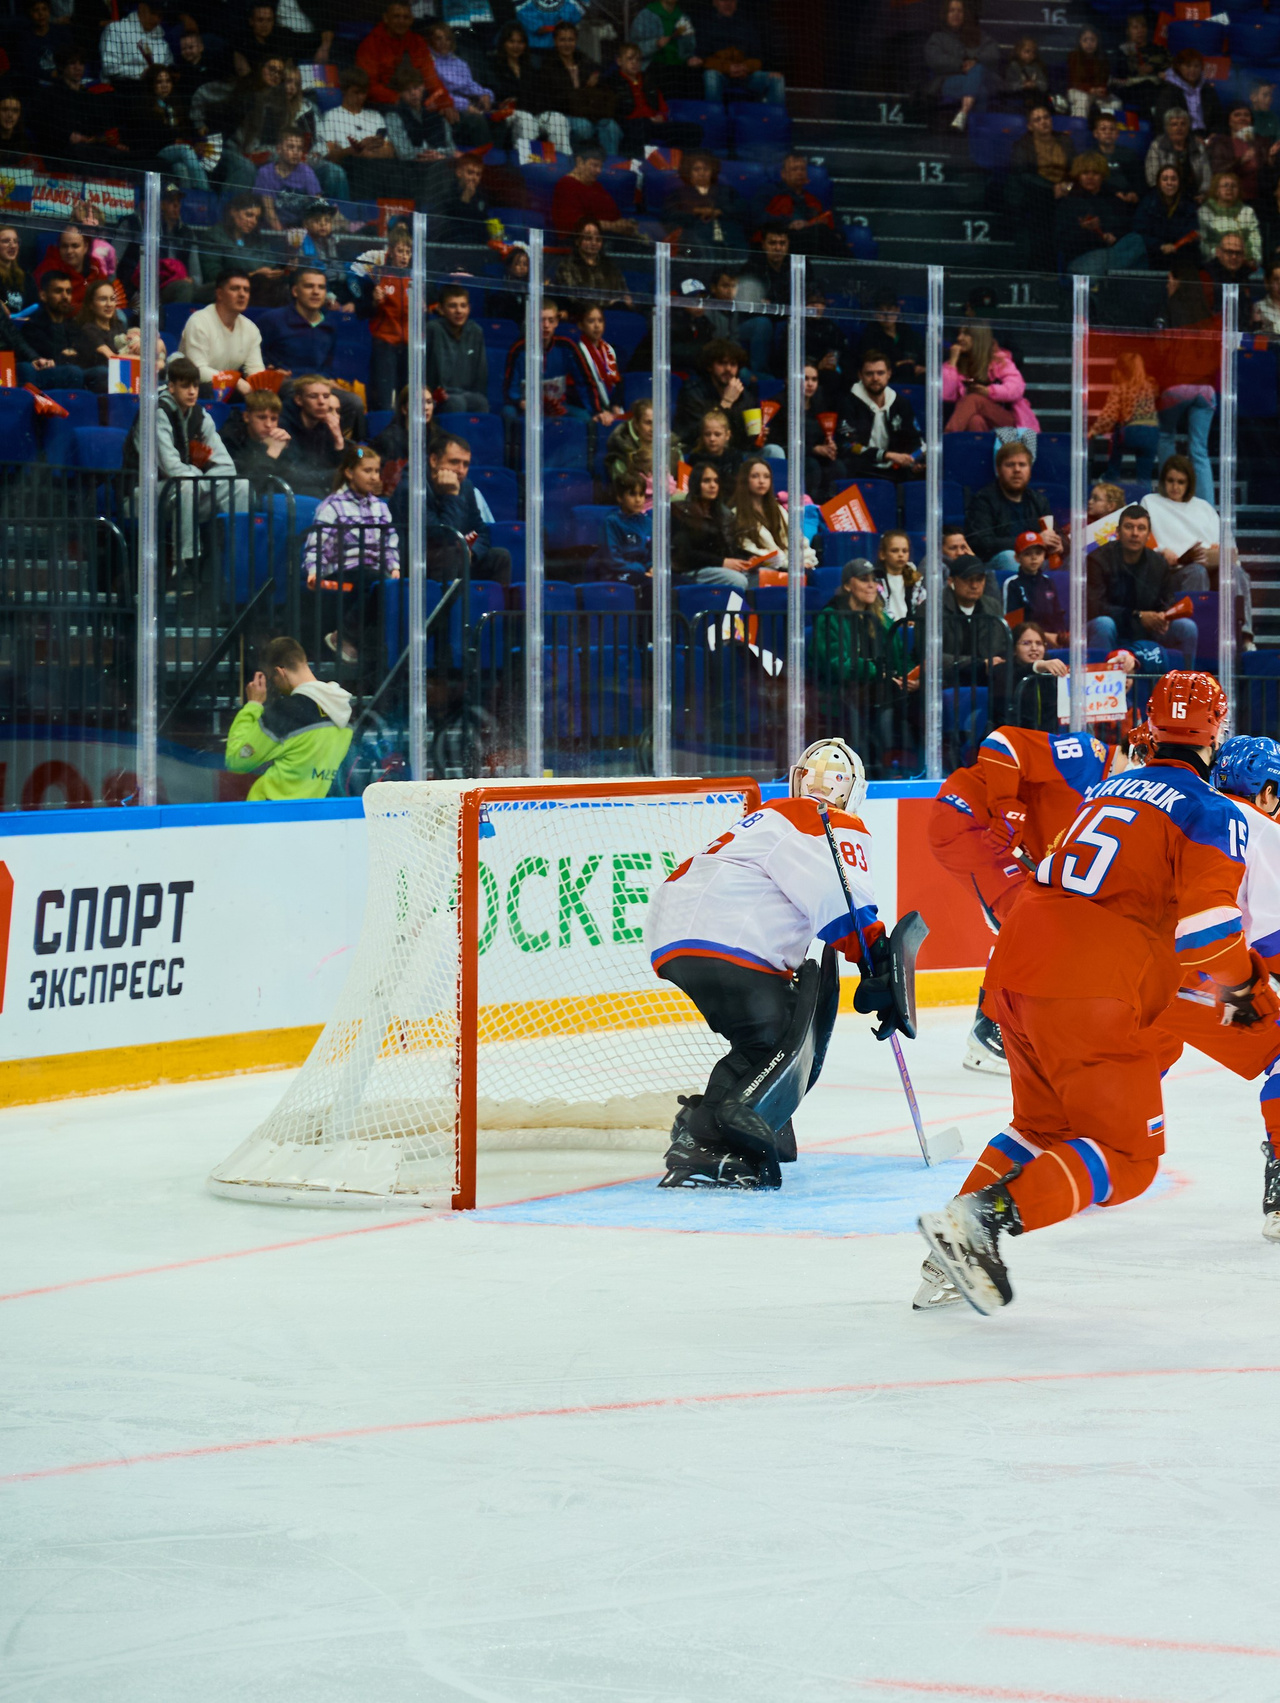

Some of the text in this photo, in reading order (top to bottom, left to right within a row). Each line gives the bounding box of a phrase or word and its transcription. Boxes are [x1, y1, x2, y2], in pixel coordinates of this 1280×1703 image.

[1041, 8, 1068, 26] 16
[878, 102, 904, 125] 14
[917, 161, 945, 184] 13
[962, 220, 991, 243] 12
[1009, 283, 1032, 305] 11
[1171, 701, 1188, 720] 15
[1053, 738, 1083, 760] 18
[1228, 818, 1248, 858] 15
[839, 840, 869, 873] 83
[1035, 804, 1140, 898] 15
[33, 880, 194, 956] СПОРТ
[28, 957, 185, 1011] ЭКСПРЕСС
[742, 1049, 785, 1097] SUPREME
